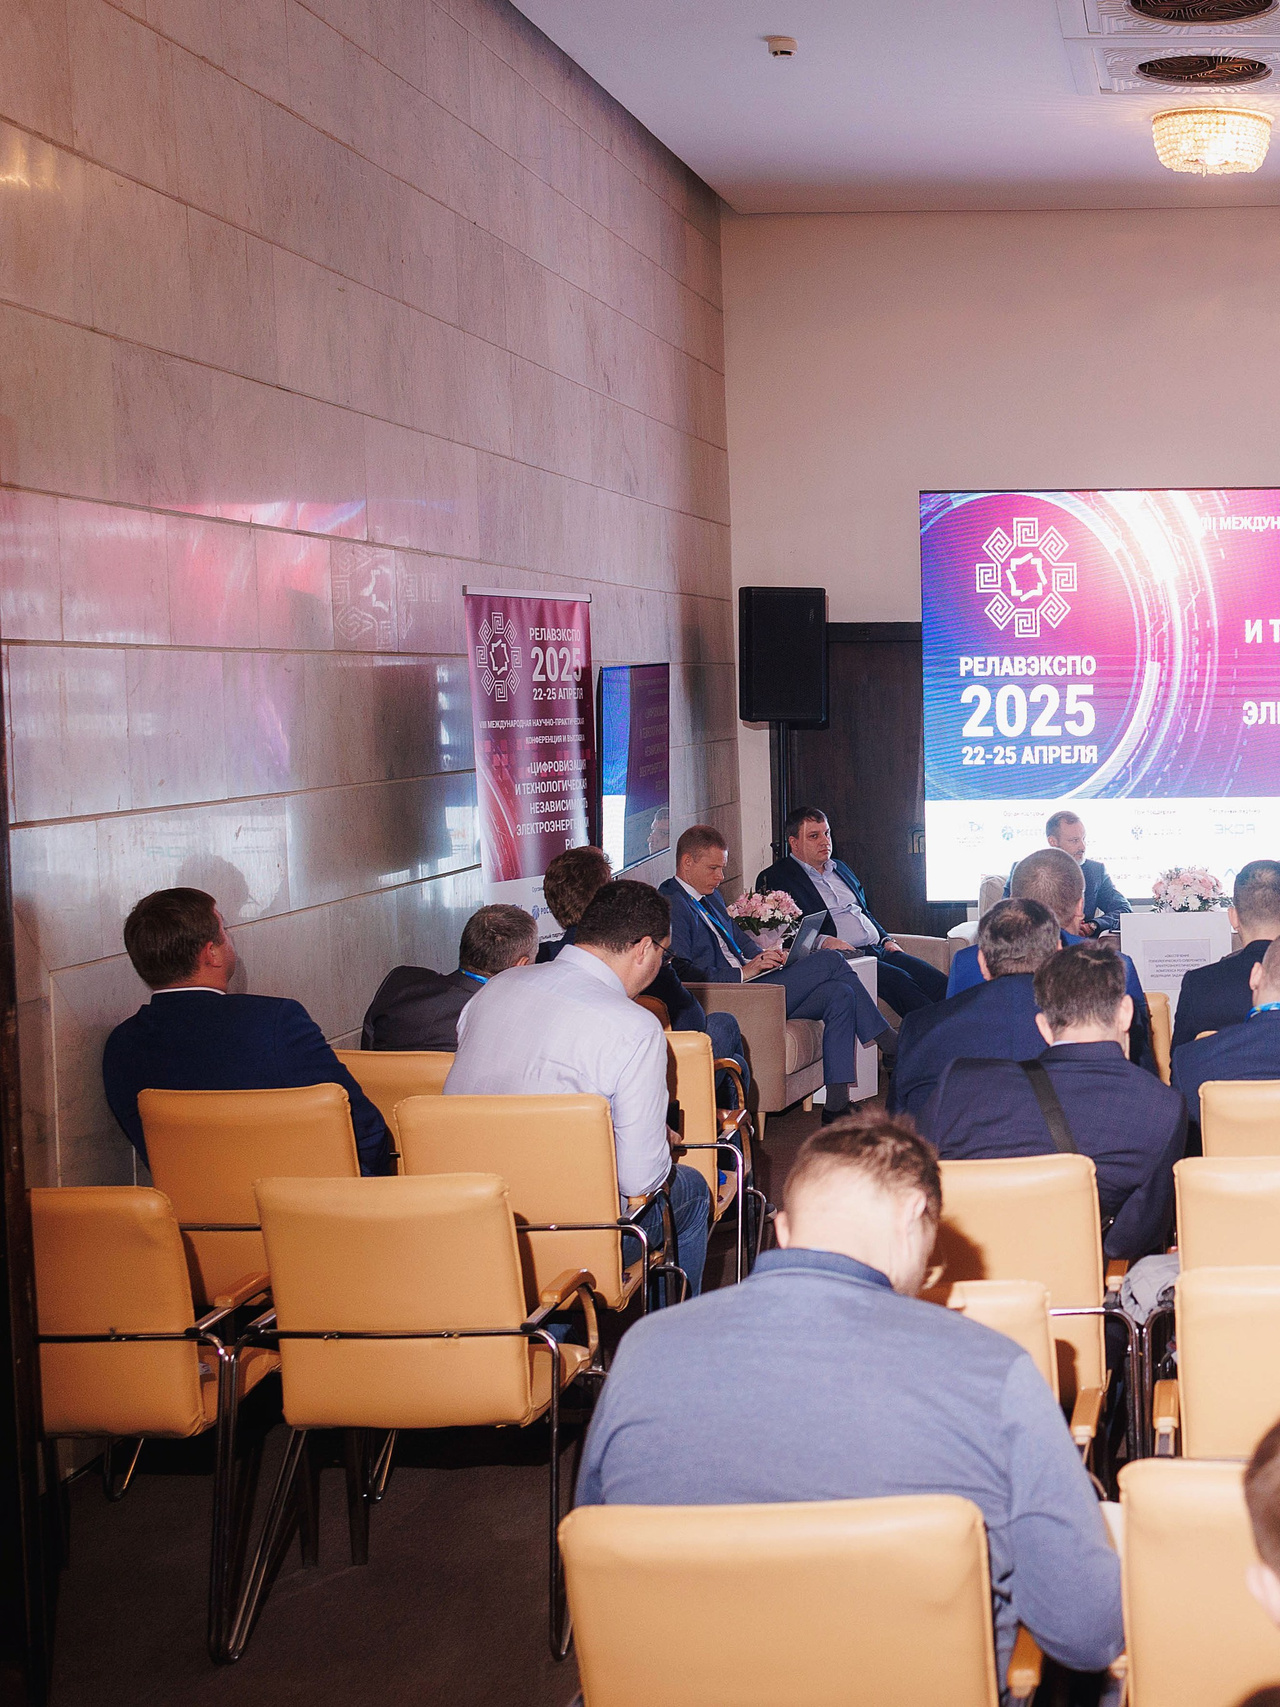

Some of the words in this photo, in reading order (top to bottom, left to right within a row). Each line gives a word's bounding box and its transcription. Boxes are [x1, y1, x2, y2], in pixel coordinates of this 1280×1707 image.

[529, 627, 581, 642] РЕЛАВЭКСПО
[1244, 620, 1263, 644] И
[530, 646, 583, 682] 2025
[959, 655, 1097, 678] РЕЛАВЭКСПО
[532, 687, 557, 701] 22-25
[558, 687, 584, 700] АПРЕЛЯ
[960, 683, 1097, 737] 2025
[487, 719, 532, 730] МЕЖДУНАРОДНАЯ
[525, 735, 562, 745] КОНФЕРЕНЦИЯ
[961, 745, 1019, 766] 22-25
[1021, 744, 1098, 765] АПРЕЛЯ
[515, 783, 521, 796] И
[522, 778, 588, 795] ТЕХНОЛОГИЧЕСКАЯ
[516, 816, 590, 836] ЭЛЕКТРОЭНЕРГИ
